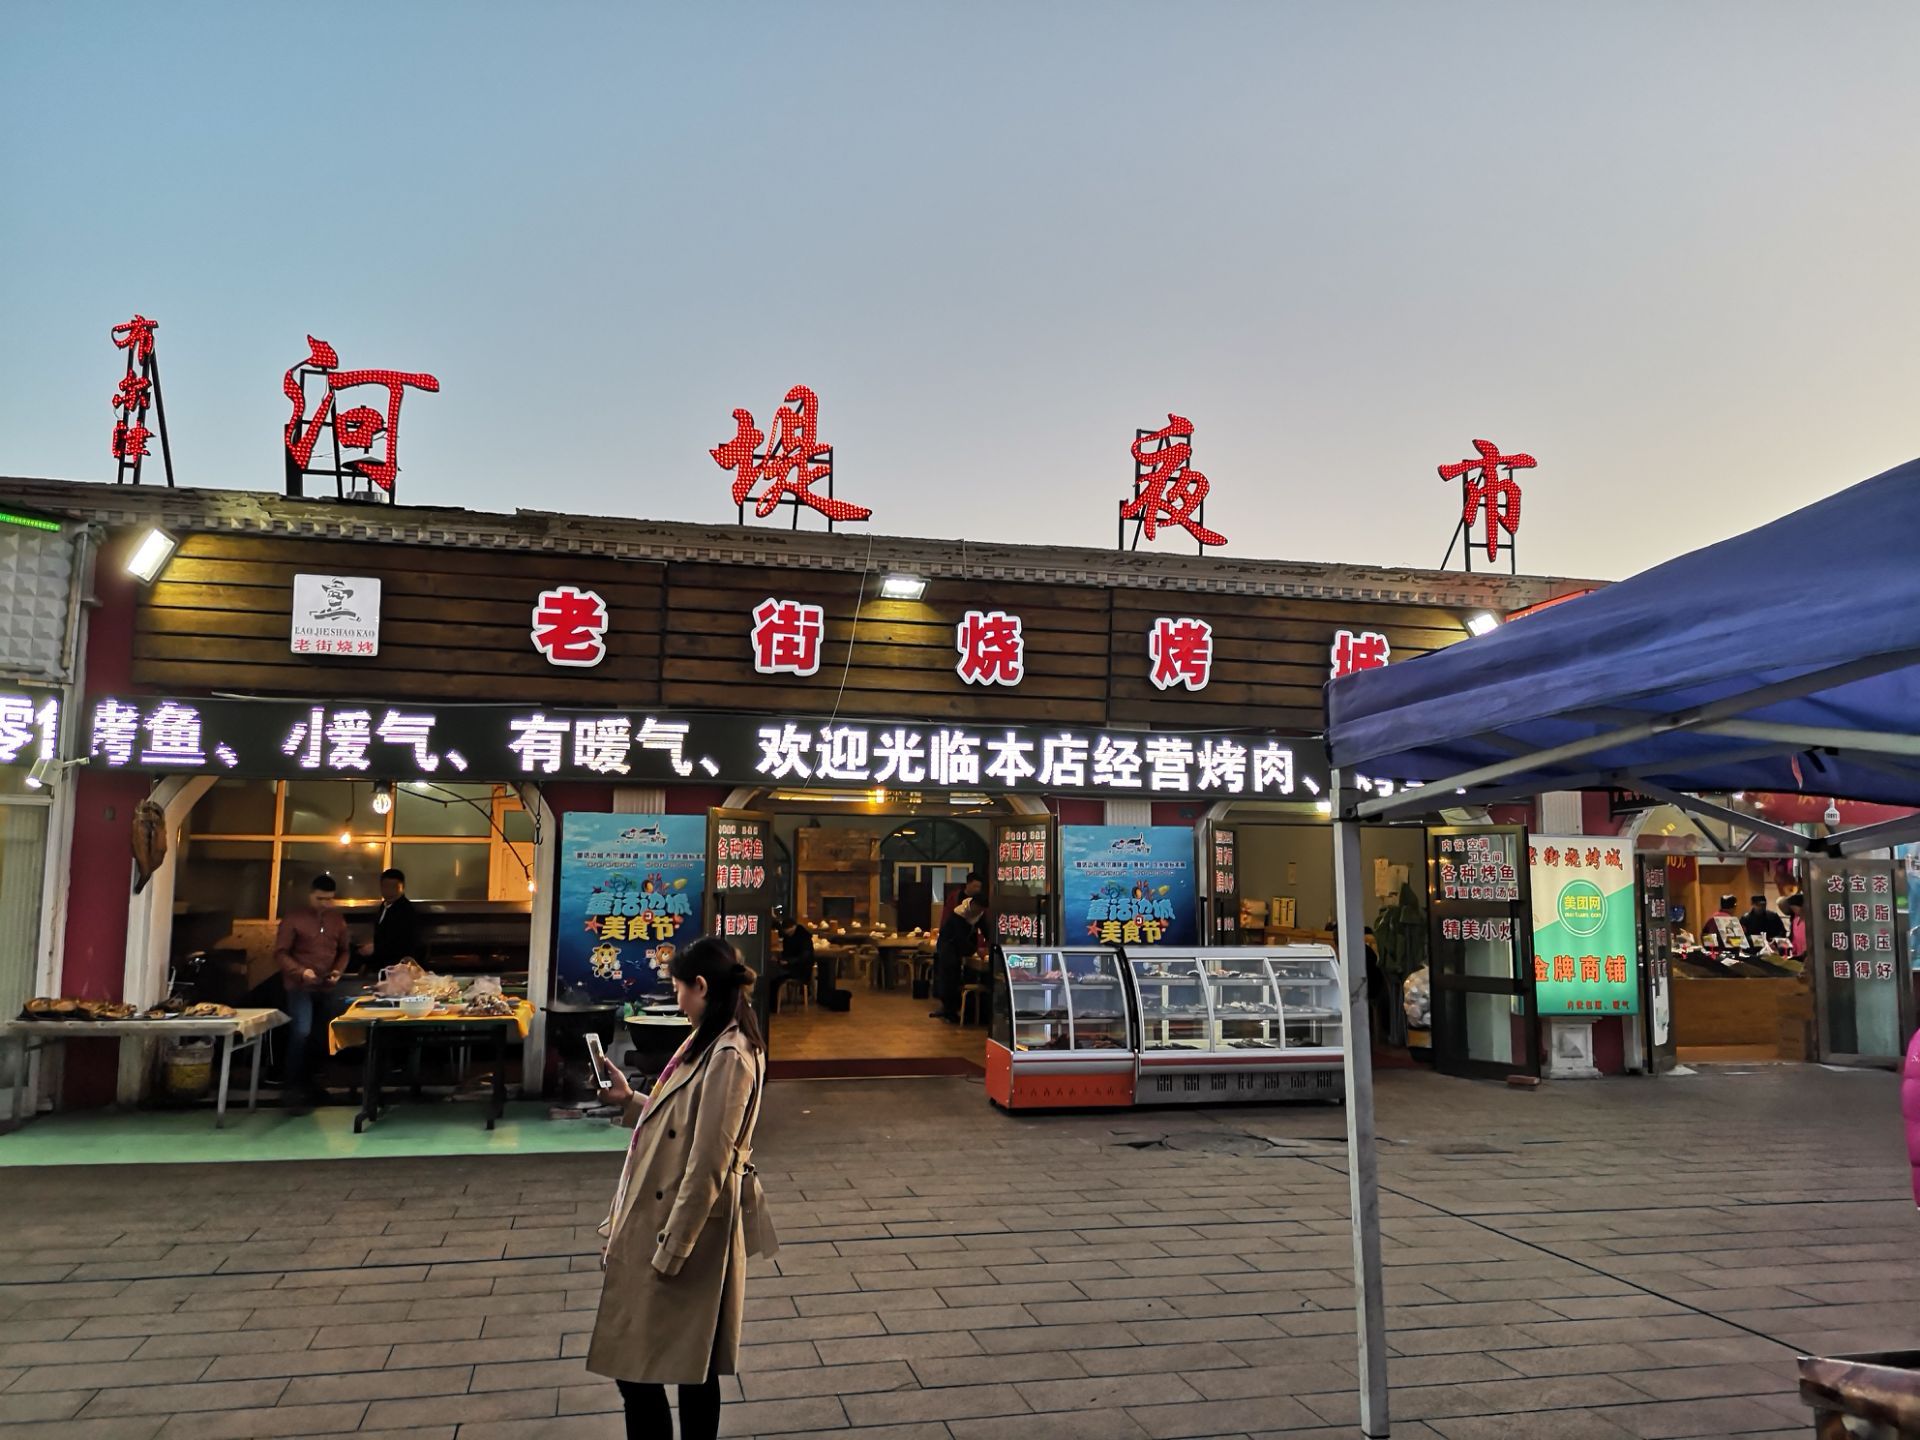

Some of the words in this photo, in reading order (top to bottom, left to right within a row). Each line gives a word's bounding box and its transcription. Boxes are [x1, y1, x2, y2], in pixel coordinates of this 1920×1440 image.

[294, 626, 313, 635] LAO
[294, 638, 374, 654] 老街烧烤
[718, 837, 763, 860] 各种烤鱼
[1468, 851, 1503, 864] 卫生间
[717, 864, 765, 888] 精美小炒
[1441, 864, 1516, 883] 各种烤鱼
[1827, 875, 1889, 893] 戈宝茶
[585, 892, 692, 917] 童话边城
[1087, 898, 1176, 921] 童话边城
[1564, 896, 1601, 911] 美团网
[1828, 904, 1891, 922] 助降脂
[600, 915, 674, 941] 美食节
[1100, 920, 1161, 944] 美食节
[1832, 932, 1892, 951] 助降压
[1534, 954, 1627, 983] 金牌商铺
[1833, 961, 1894, 980] 睡得好
